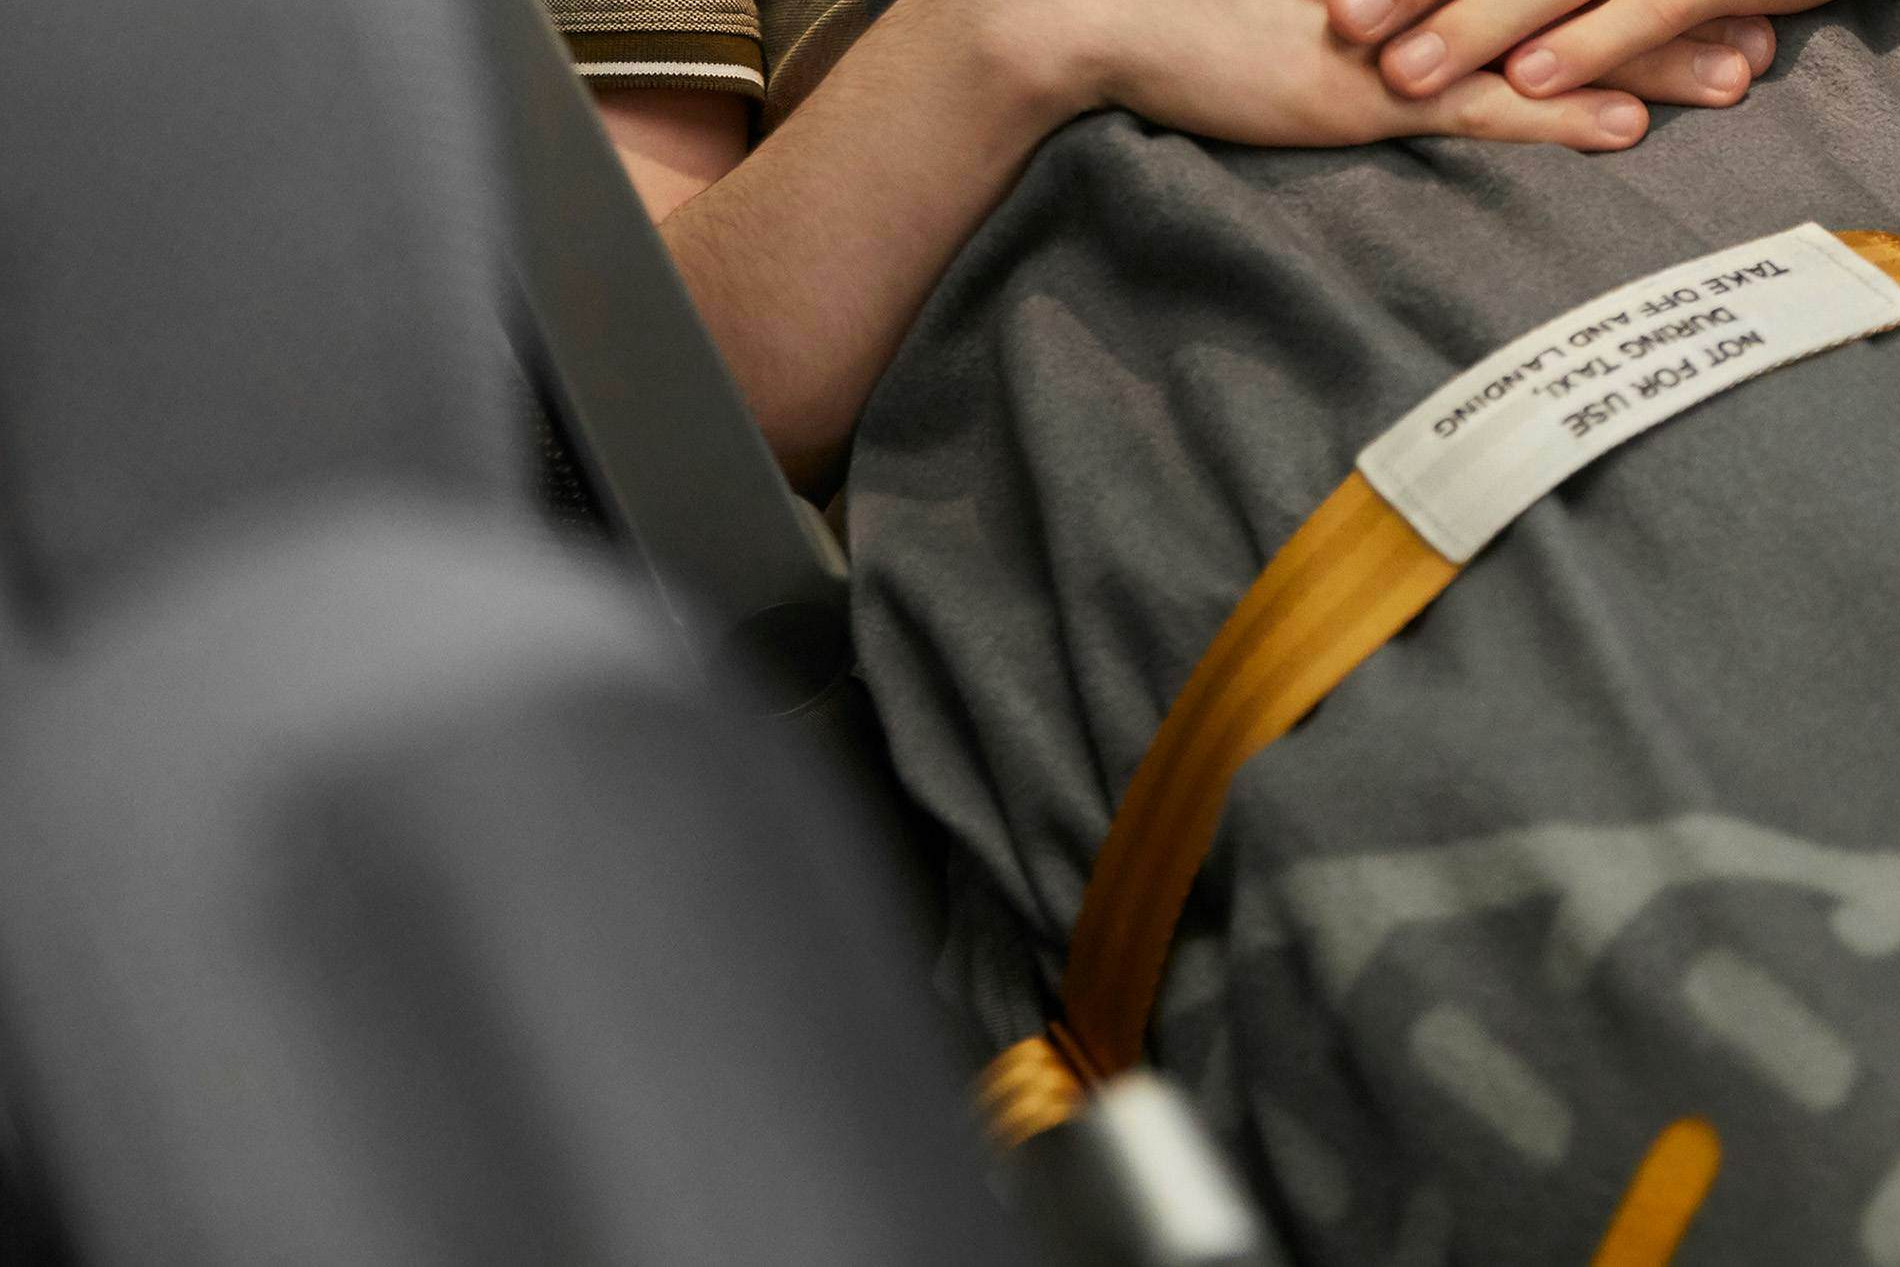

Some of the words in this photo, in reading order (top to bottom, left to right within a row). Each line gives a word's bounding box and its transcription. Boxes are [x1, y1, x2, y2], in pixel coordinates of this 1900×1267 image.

[1701, 259, 1790, 295] TAKE
[1640, 288, 1701, 317] OFF
[1569, 311, 1631, 347] AND
[1618, 306, 1738, 359] DURING
[1704, 330, 1765, 367] NOT
[1433, 346, 1567, 438] LANDING
[1630, 358, 1698, 399] FOR
[1562, 391, 1631, 438] USE
